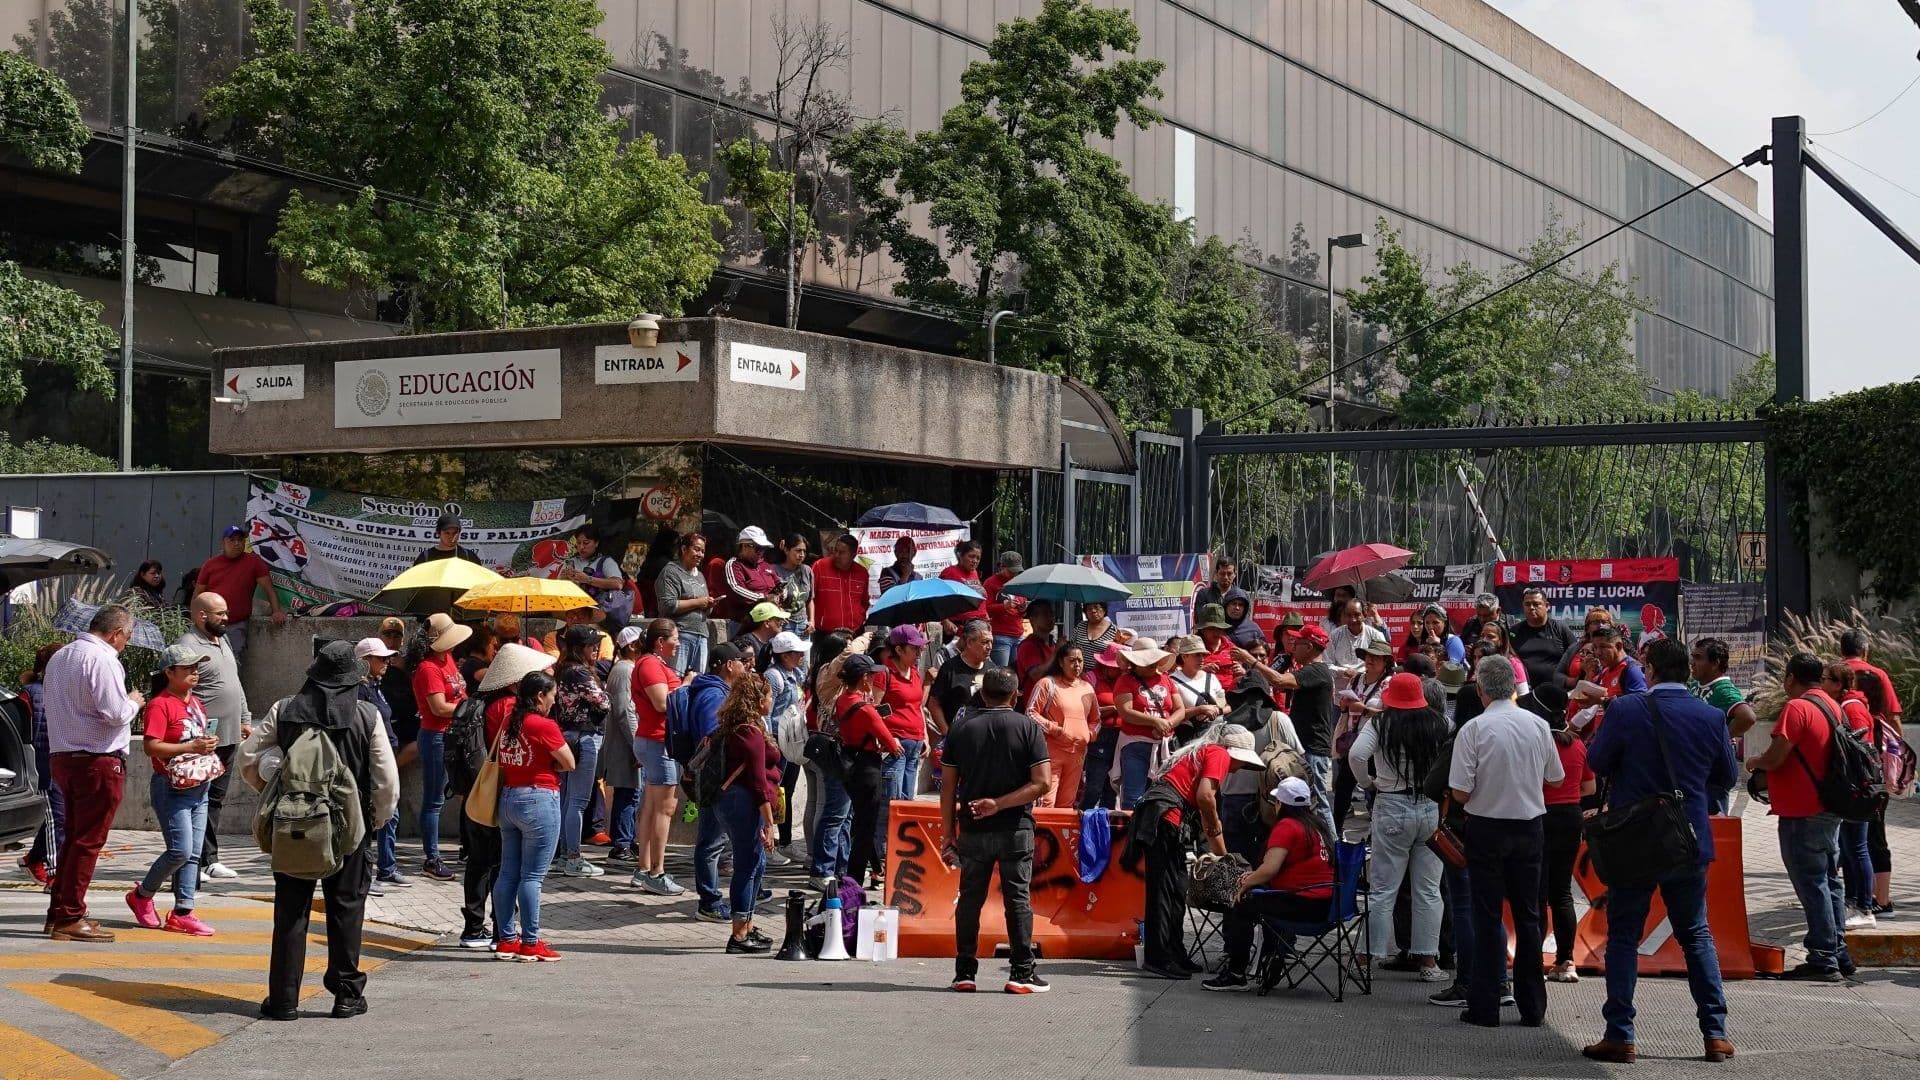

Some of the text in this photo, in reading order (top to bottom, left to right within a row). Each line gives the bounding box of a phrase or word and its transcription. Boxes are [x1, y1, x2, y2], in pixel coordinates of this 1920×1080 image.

[604, 357, 665, 372] ENTRADA
[737, 357, 782, 376] ENTRADA
[256, 376, 293, 388] SALIDA
[399, 363, 536, 395] EDUCACIÓN
[445, 398, 480, 406] EDUCACIÓN
[361, 497, 441, 518] Sección
[356, 523, 417, 539] CUMPLA
[460, 532, 479, 540] SU
[869, 545, 892, 554] MUNDO
[325, 552, 366, 566] PENSIONES
[349, 568, 384, 579] AUMENTO
[1413, 583, 1440, 598] CNTE
[1580, 587, 1596, 598] DE
[1600, 586, 1646, 598] LUCHA
